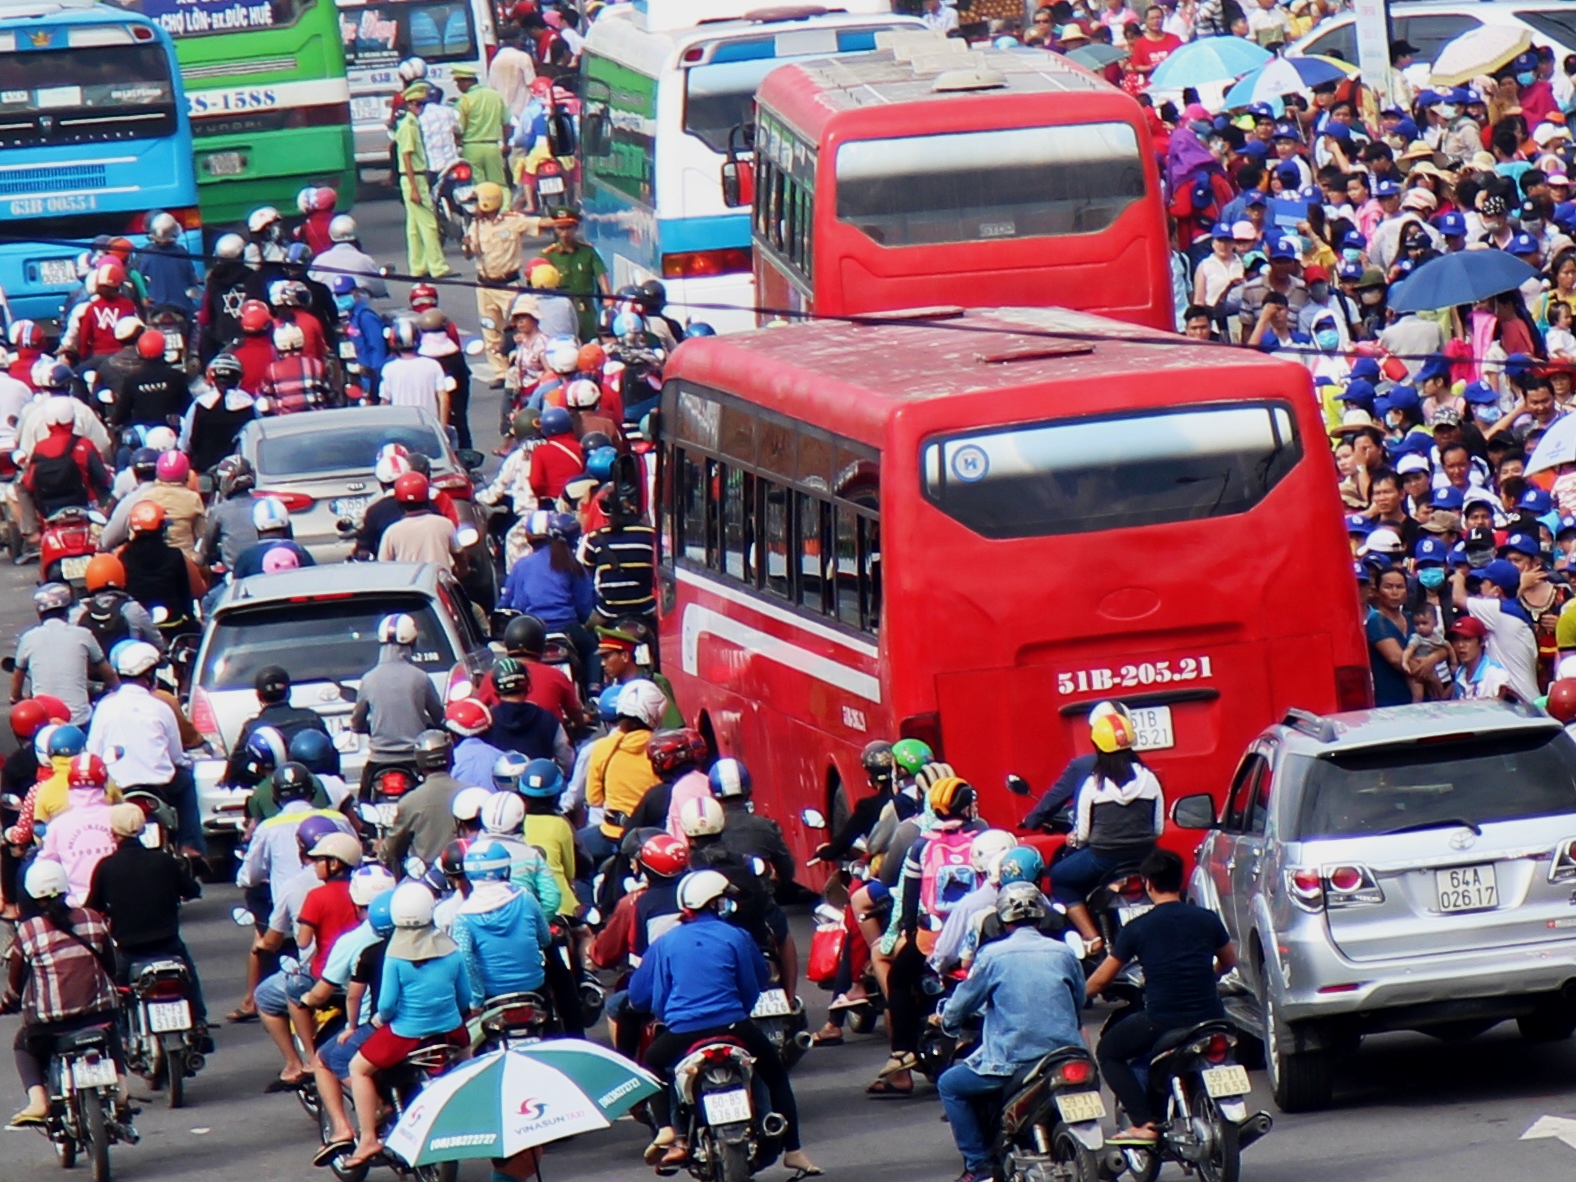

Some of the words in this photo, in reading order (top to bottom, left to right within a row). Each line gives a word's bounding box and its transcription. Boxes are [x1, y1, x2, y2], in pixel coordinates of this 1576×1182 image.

[193, 119, 263, 134] YUNDAI
[1057, 656, 1212, 694] 51B-205.21
[1449, 870, 1482, 888] 64A
[1439, 885, 1495, 910] 026.17
[514, 1114, 566, 1136] VINASUN
[565, 1110, 587, 1122] TAXI
